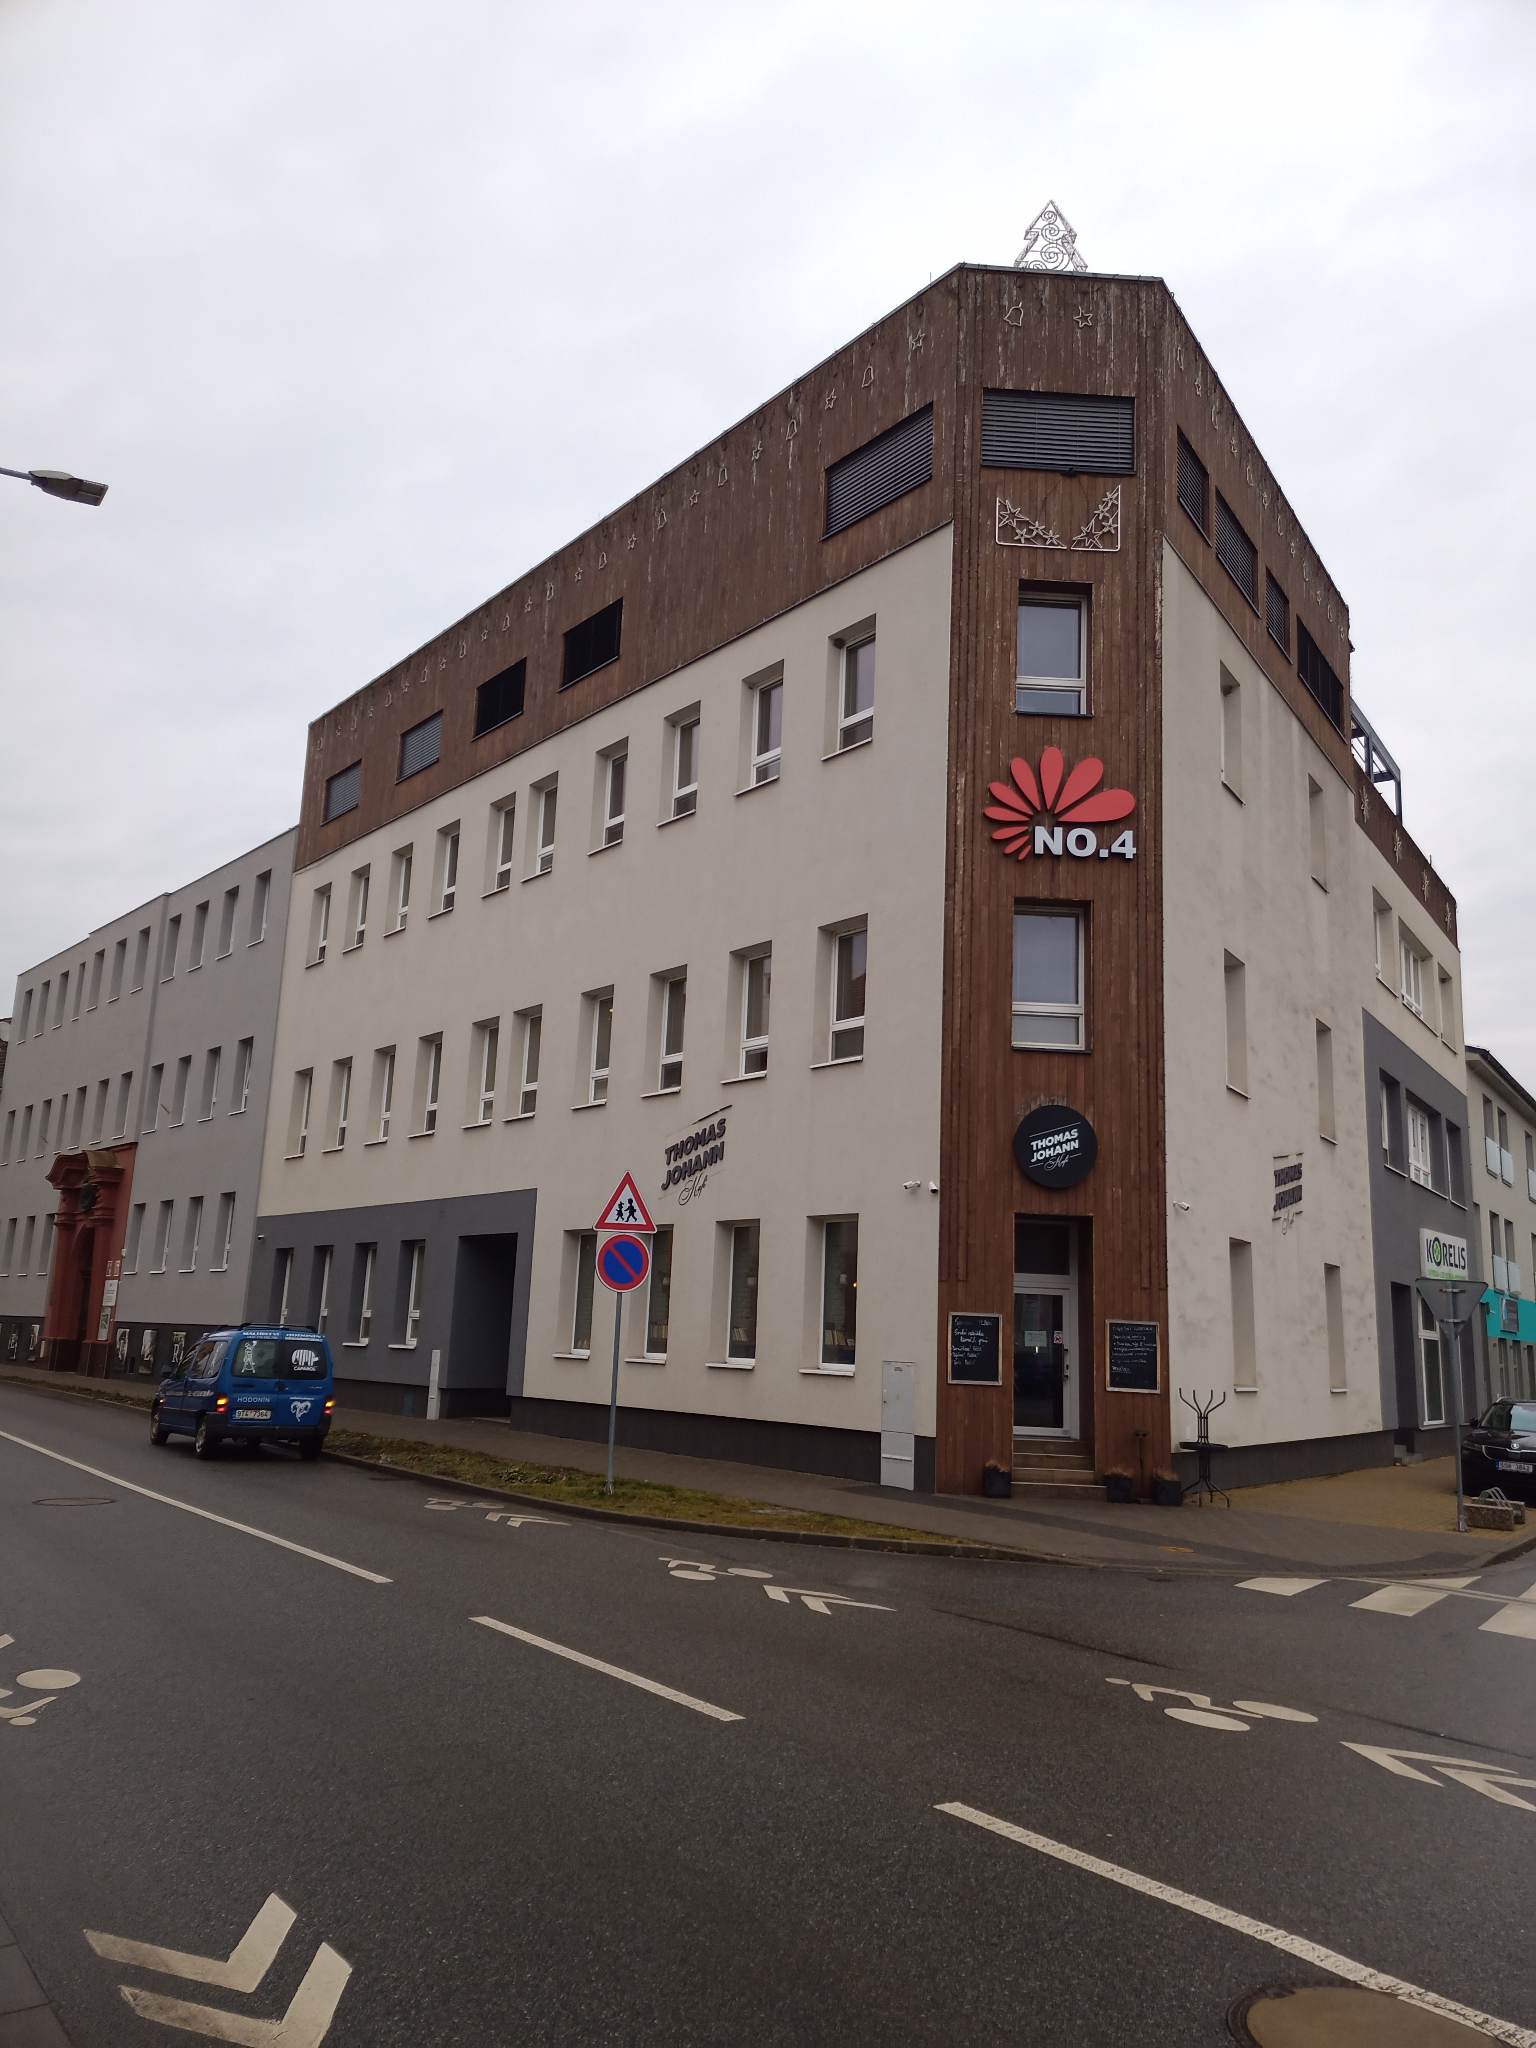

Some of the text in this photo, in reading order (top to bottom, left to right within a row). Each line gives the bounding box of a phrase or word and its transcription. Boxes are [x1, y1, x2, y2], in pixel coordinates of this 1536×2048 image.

[1034, 826, 1137, 859] NO.4
[664, 1118, 727, 1166] THOMAS
[1030, 1129, 1079, 1151] THOMAS
[1030, 1140, 1079, 1163] JOHANN
[661, 1141, 725, 1191] JOHANN
[1273, 1163, 1302, 1188] THOMAS
[1273, 1185, 1302, 1212] JOHANN
[1425, 1236, 1466, 1270] KORELIS
